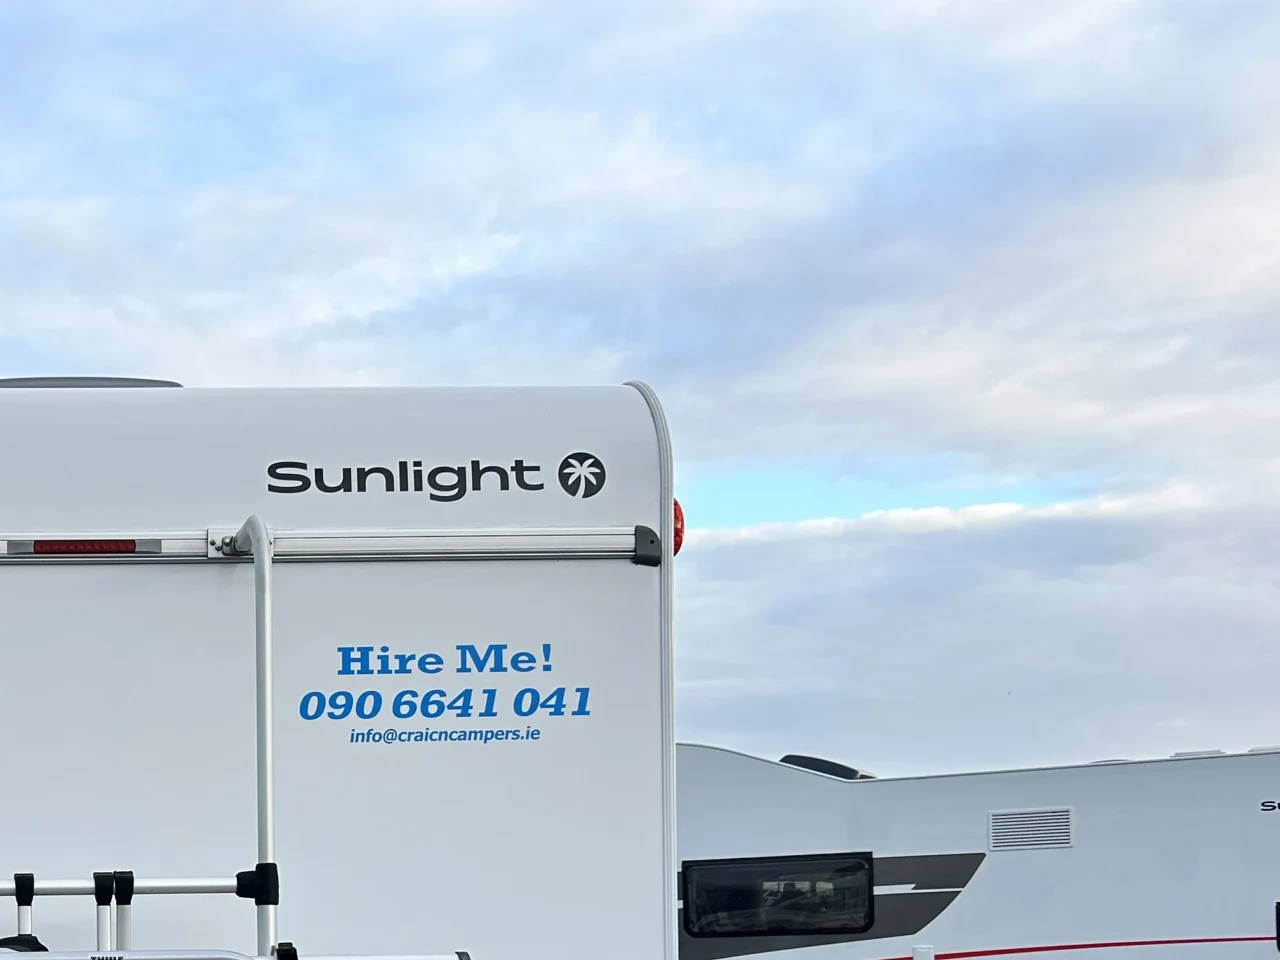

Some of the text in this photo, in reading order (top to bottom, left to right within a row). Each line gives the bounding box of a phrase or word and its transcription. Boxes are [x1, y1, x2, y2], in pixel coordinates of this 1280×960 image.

[267, 460, 545, 502] Sunlight
[337, 643, 553, 675] Hire Me!
[299, 687, 591, 721] 090 6641 041
[349, 726, 541, 744] info@craicncampers.ie
